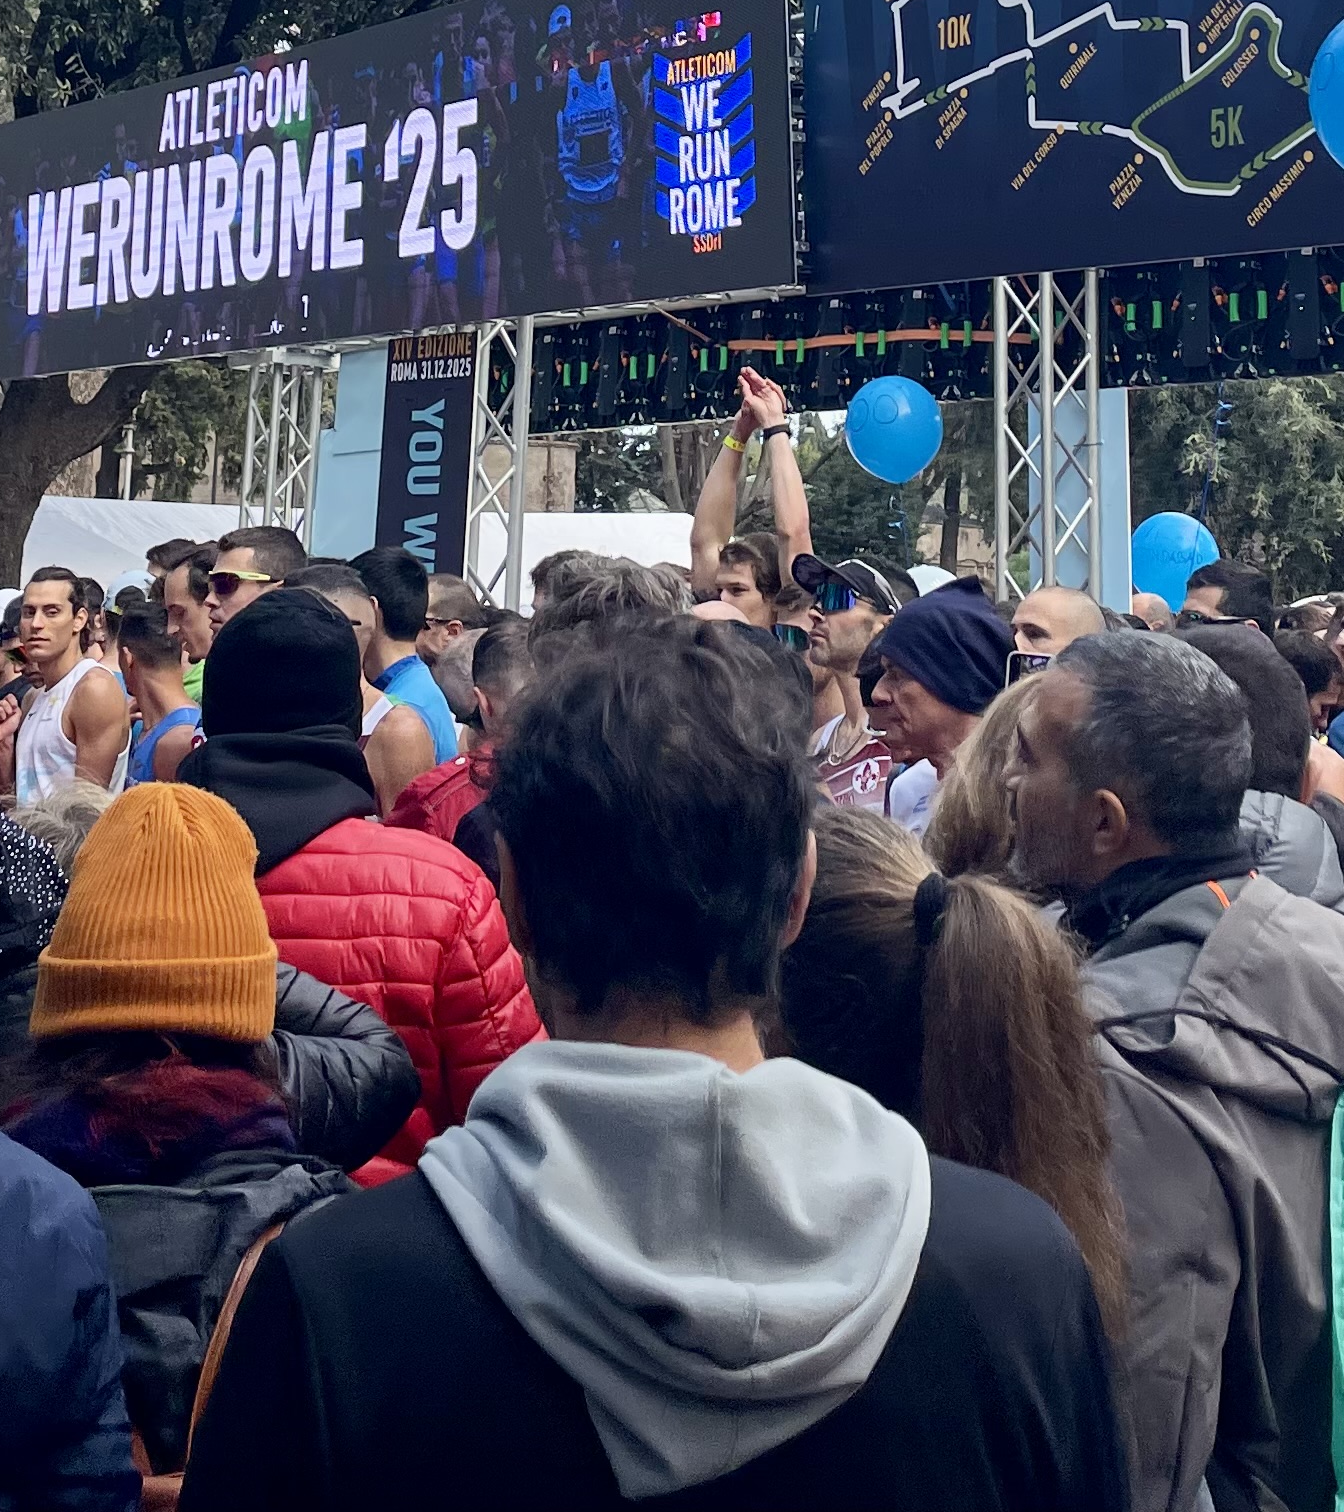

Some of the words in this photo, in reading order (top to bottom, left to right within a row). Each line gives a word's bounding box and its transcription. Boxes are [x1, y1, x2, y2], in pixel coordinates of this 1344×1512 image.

[937, 13, 972, 50] 10K
[1198, 15, 1214, 33] VIA
[1210, 0, 1226, 18] DEI
[666, 48, 736, 86] ATLETICOM
[1059, 42, 1098, 90] QUIRINALE
[1221, 42, 1259, 88] COLOSSEO
[158, 58, 309, 153] ATLETICOM
[680, 79, 723, 132] WE
[862, 79, 886, 112] PINCIO
[938, 97, 962, 128] PIAZZA
[865, 119, 888, 149] PIAZZA
[935, 135, 945, 150] DI
[942, 107, 967, 140] SPAGNA
[1210, 104, 1245, 149] 5K
[678, 128, 731, 183] RUN
[858, 157, 872, 176] DEL
[869, 128, 894, 161] POPOLO
[1010, 173, 1025, 190] VIA
[1022, 159, 1037, 178] DEL
[1034, 132, 1058, 163] CORSO
[1109, 163, 1136, 196] PIAZZA
[1112, 174, 1143, 210] VENEZIA
[1246, 196, 1272, 227] CIRCO
[1268, 159, 1305, 202] MASSIMO
[26, 123, 367, 316] WERUNROME
[383, 97, 479, 258] '25
[669, 178, 742, 235] ROME
[390, 361, 418, 382] ROMA
[420, 357, 472, 381] 31.12.2025
[392, 339, 413, 361] XIV
[417, 333, 472, 359] EDIZIONE
[406, 398, 446, 496] YOU
